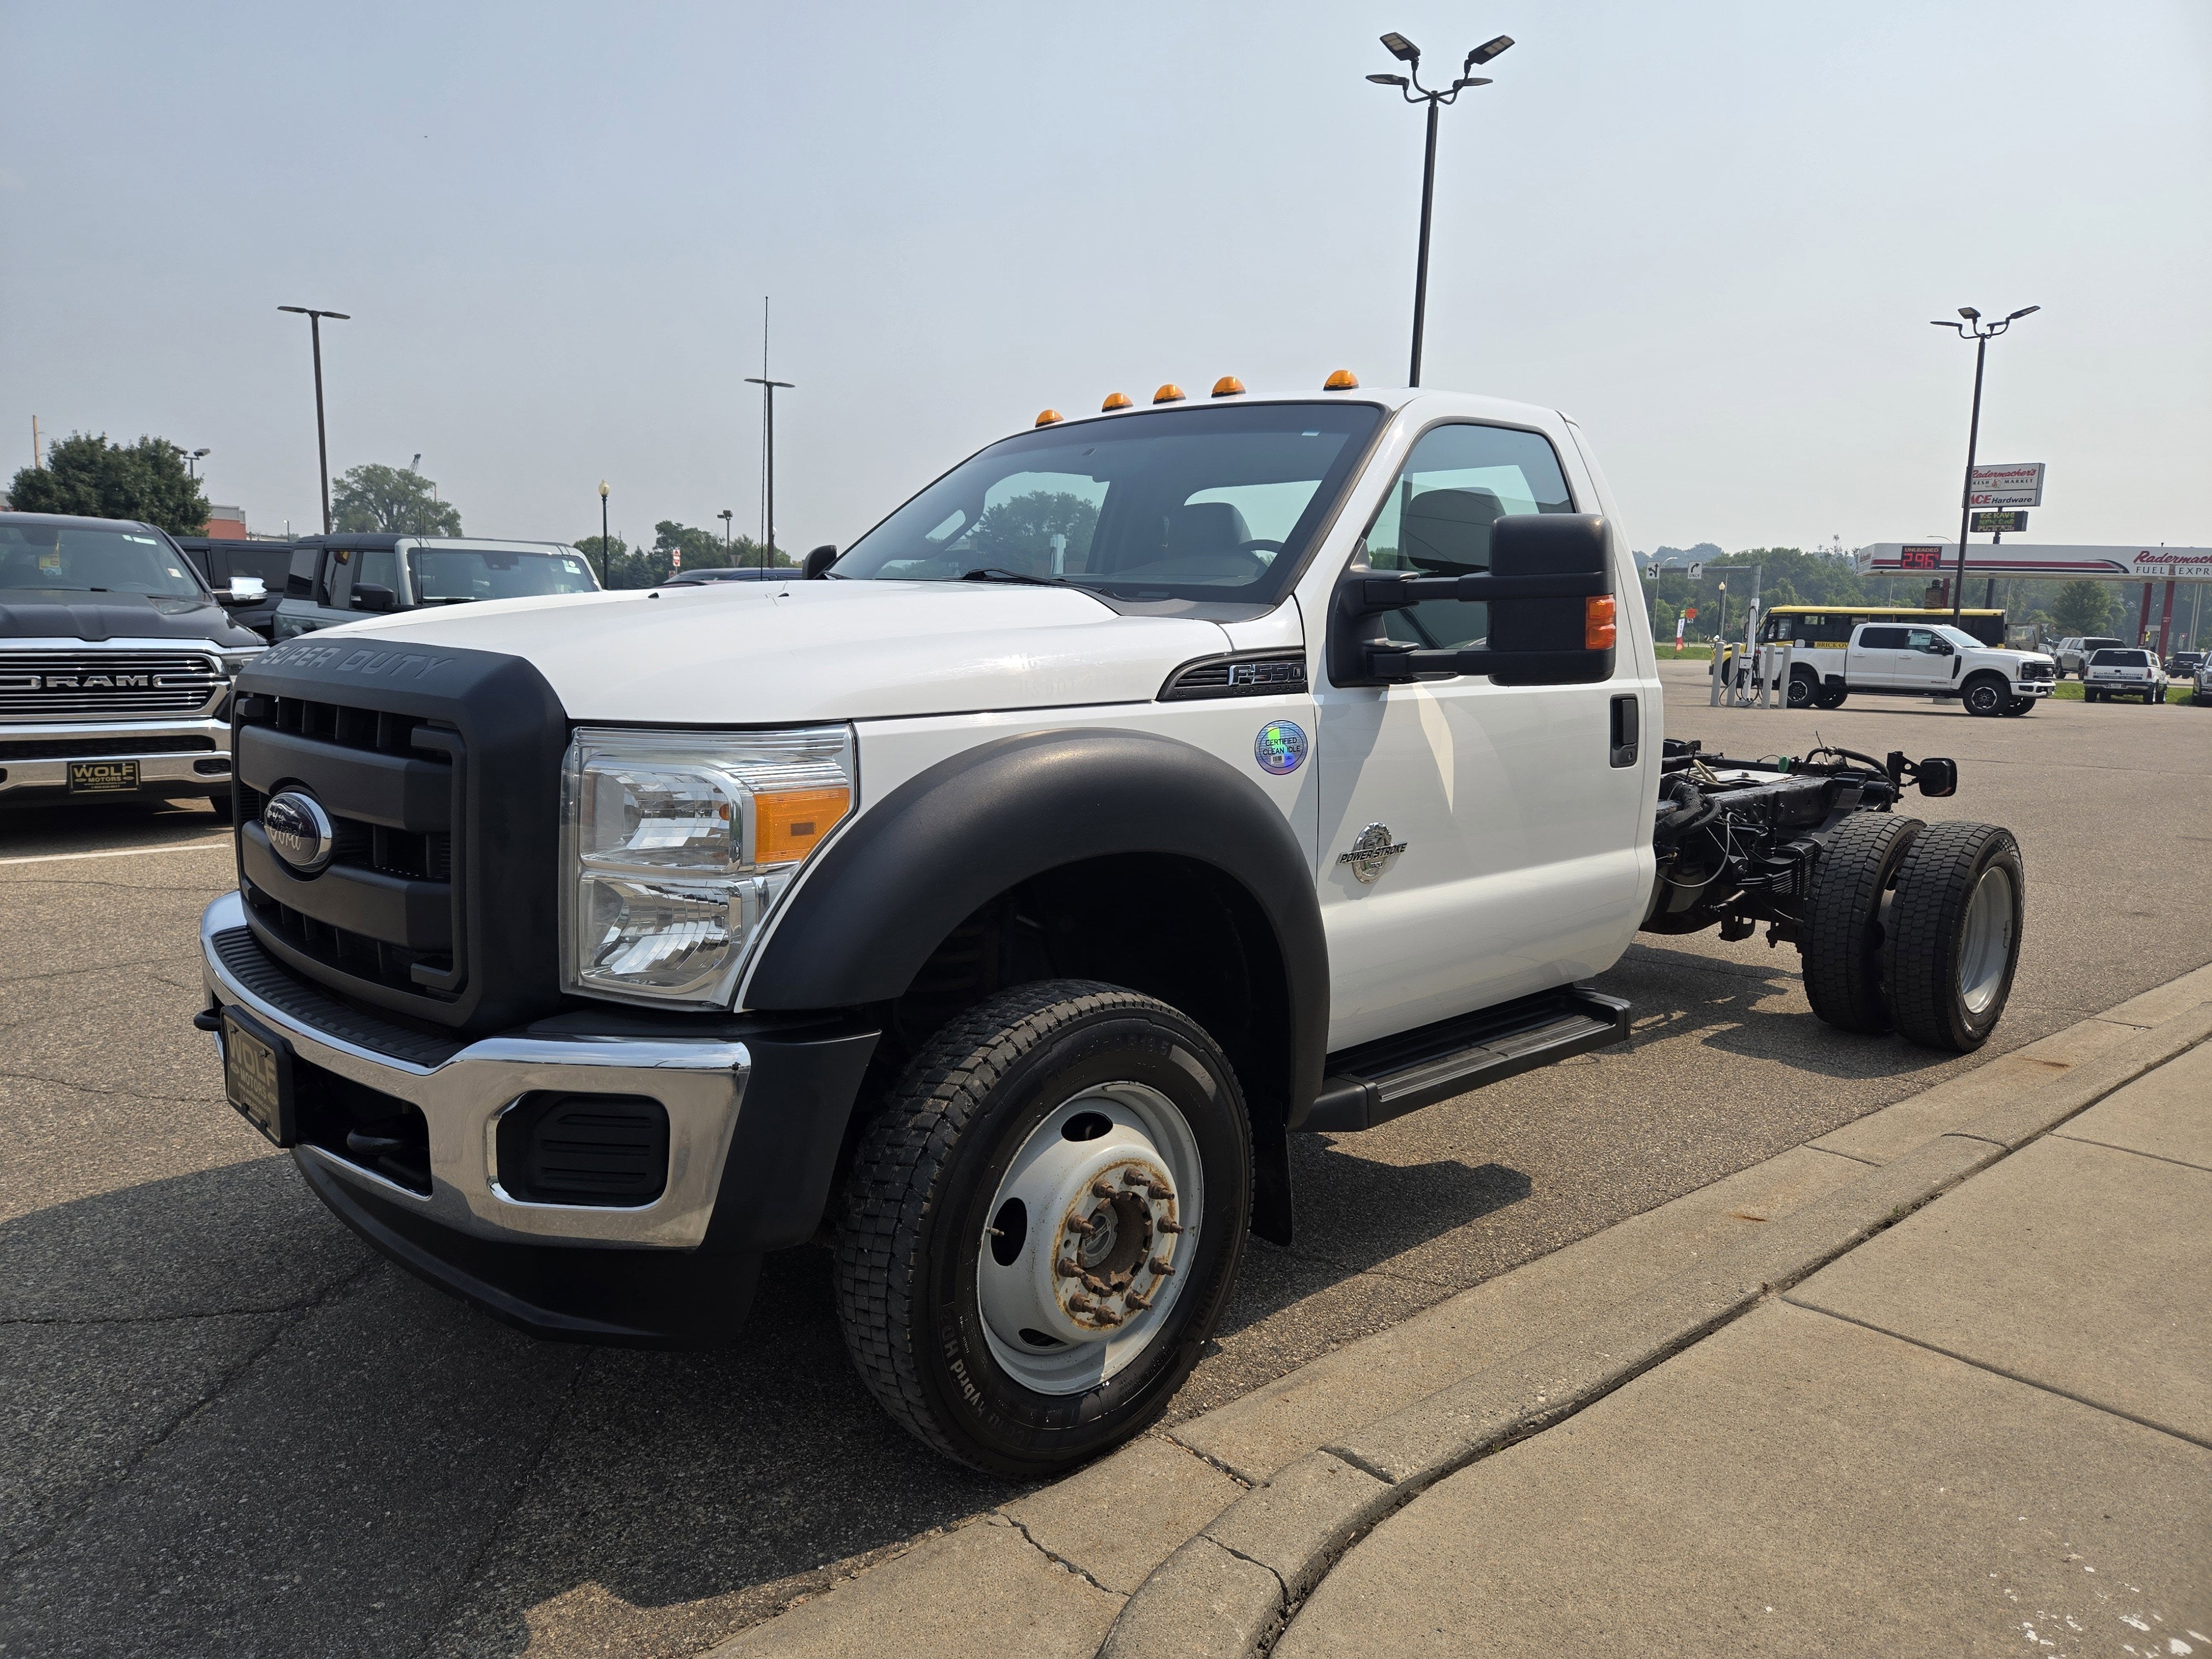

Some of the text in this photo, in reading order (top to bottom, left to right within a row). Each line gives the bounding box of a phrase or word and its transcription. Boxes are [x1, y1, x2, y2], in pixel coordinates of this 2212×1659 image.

[261, 646, 455, 680] SUPER DUTY
[46, 676, 148, 687] RAM
[1229, 664, 1306, 686] F-550
[1262, 747, 1284, 755] CLEAN
[1265, 737, 1297, 746] CERTIFIED
[74, 765, 134, 778] WOLF
[269, 821, 302, 852] Ford
[228, 1030, 276, 1087] WOLF
[240, 1067, 267, 1100] MOTORS
